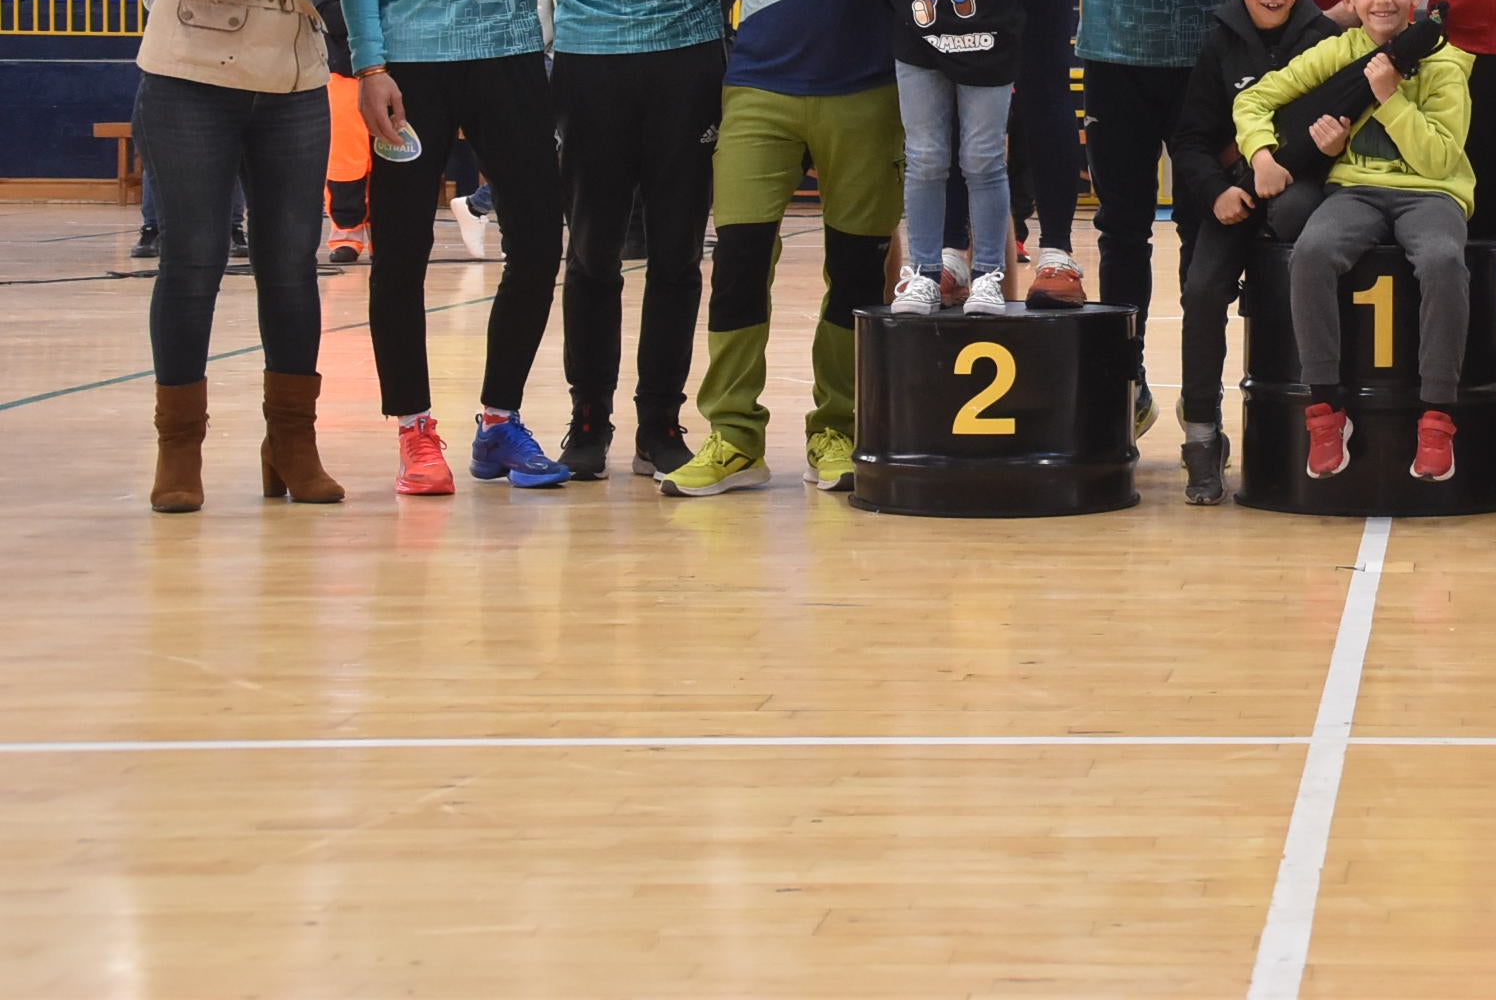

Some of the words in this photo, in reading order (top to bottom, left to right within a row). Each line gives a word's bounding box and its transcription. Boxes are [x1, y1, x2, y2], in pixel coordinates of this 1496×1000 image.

[940, 33, 994, 51] MARIO
[1353, 275, 1393, 367] 1
[952, 341, 1016, 434] 2
